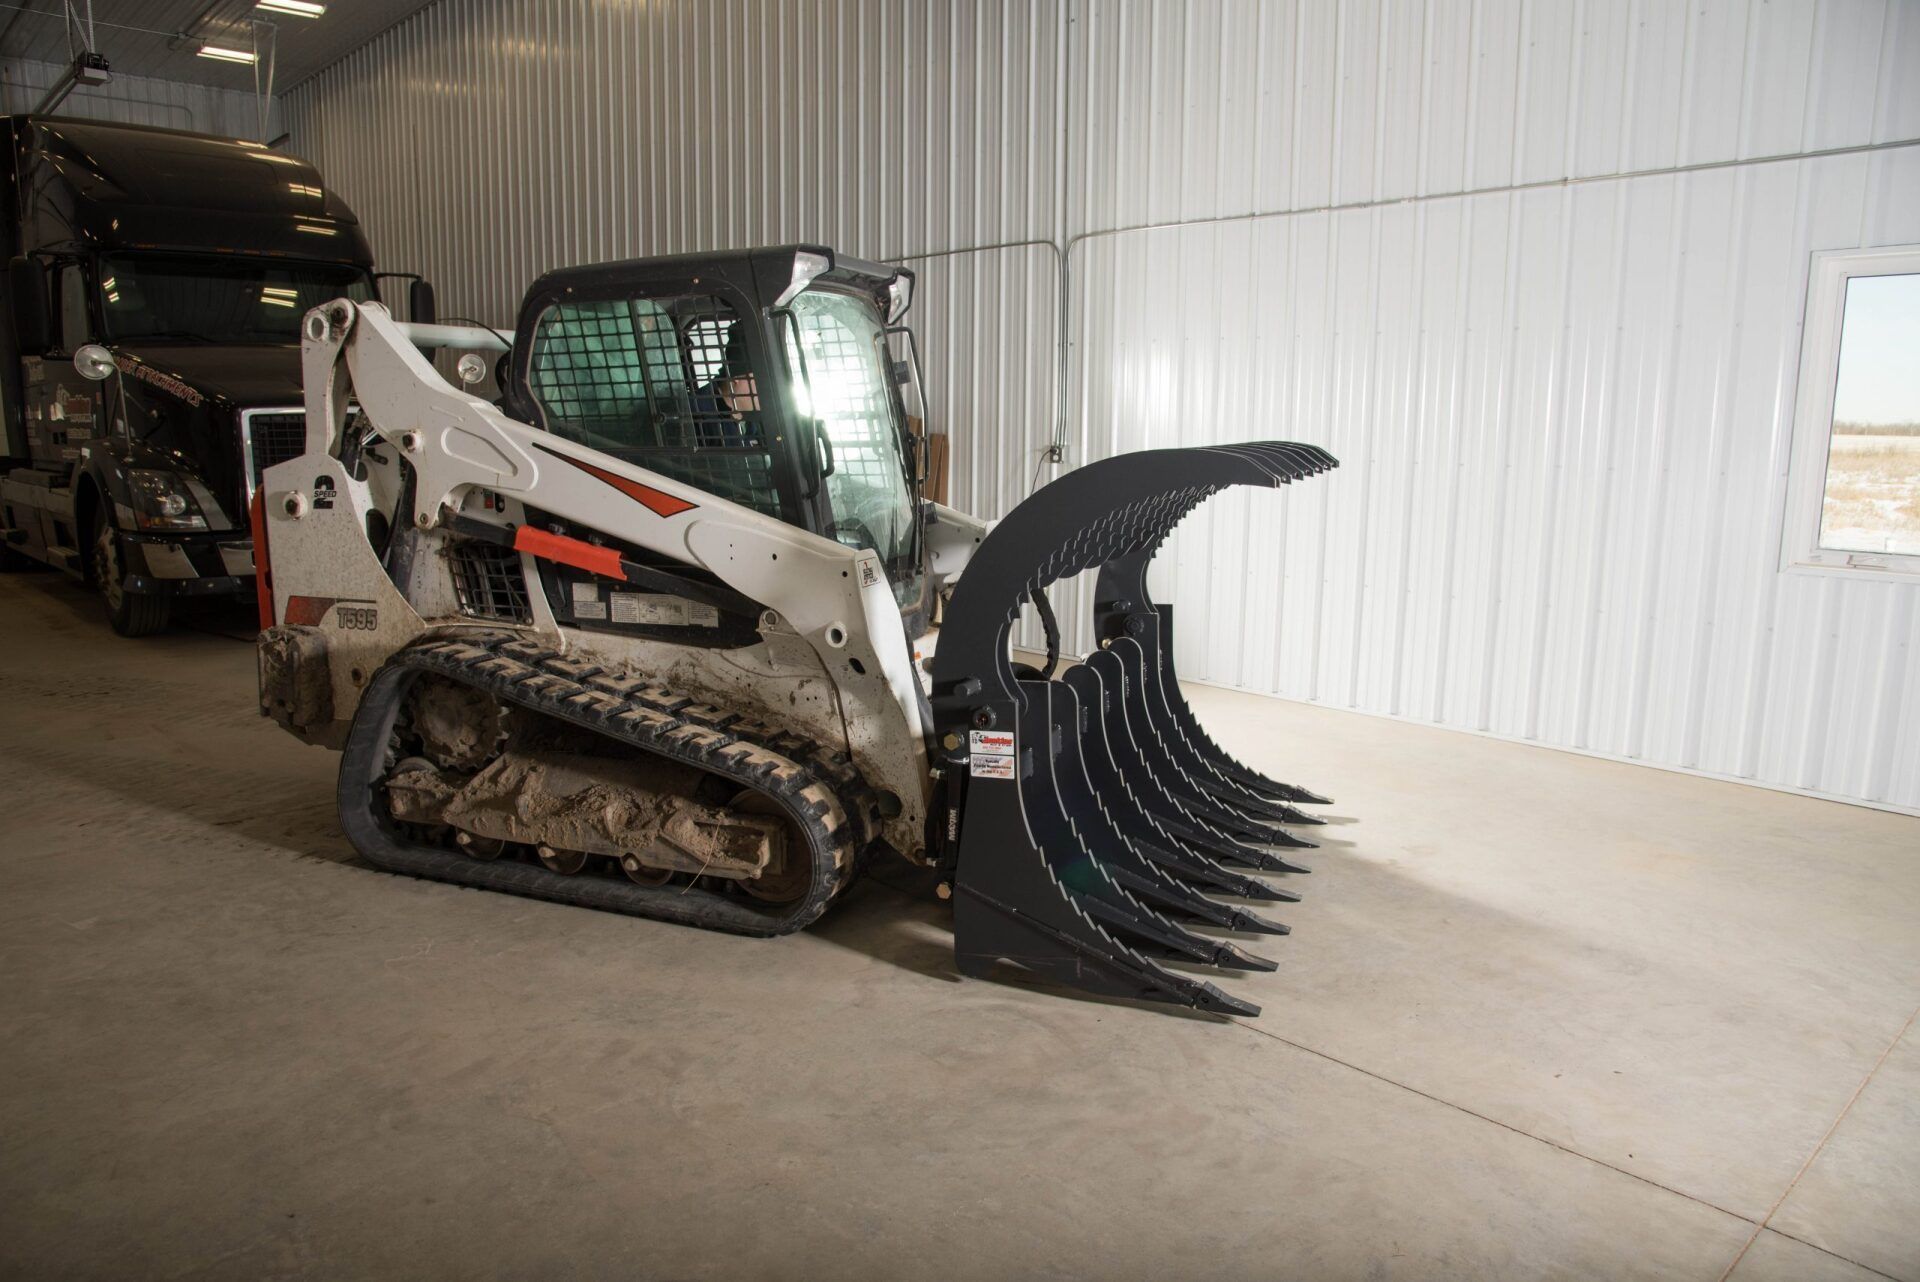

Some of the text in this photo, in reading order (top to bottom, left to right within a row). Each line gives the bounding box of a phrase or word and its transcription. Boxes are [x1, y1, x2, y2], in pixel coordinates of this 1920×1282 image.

[135, 364, 205, 408] ATTACHMENTS
[314, 490, 337, 498] SPEED
[336, 607, 377, 631] T595
